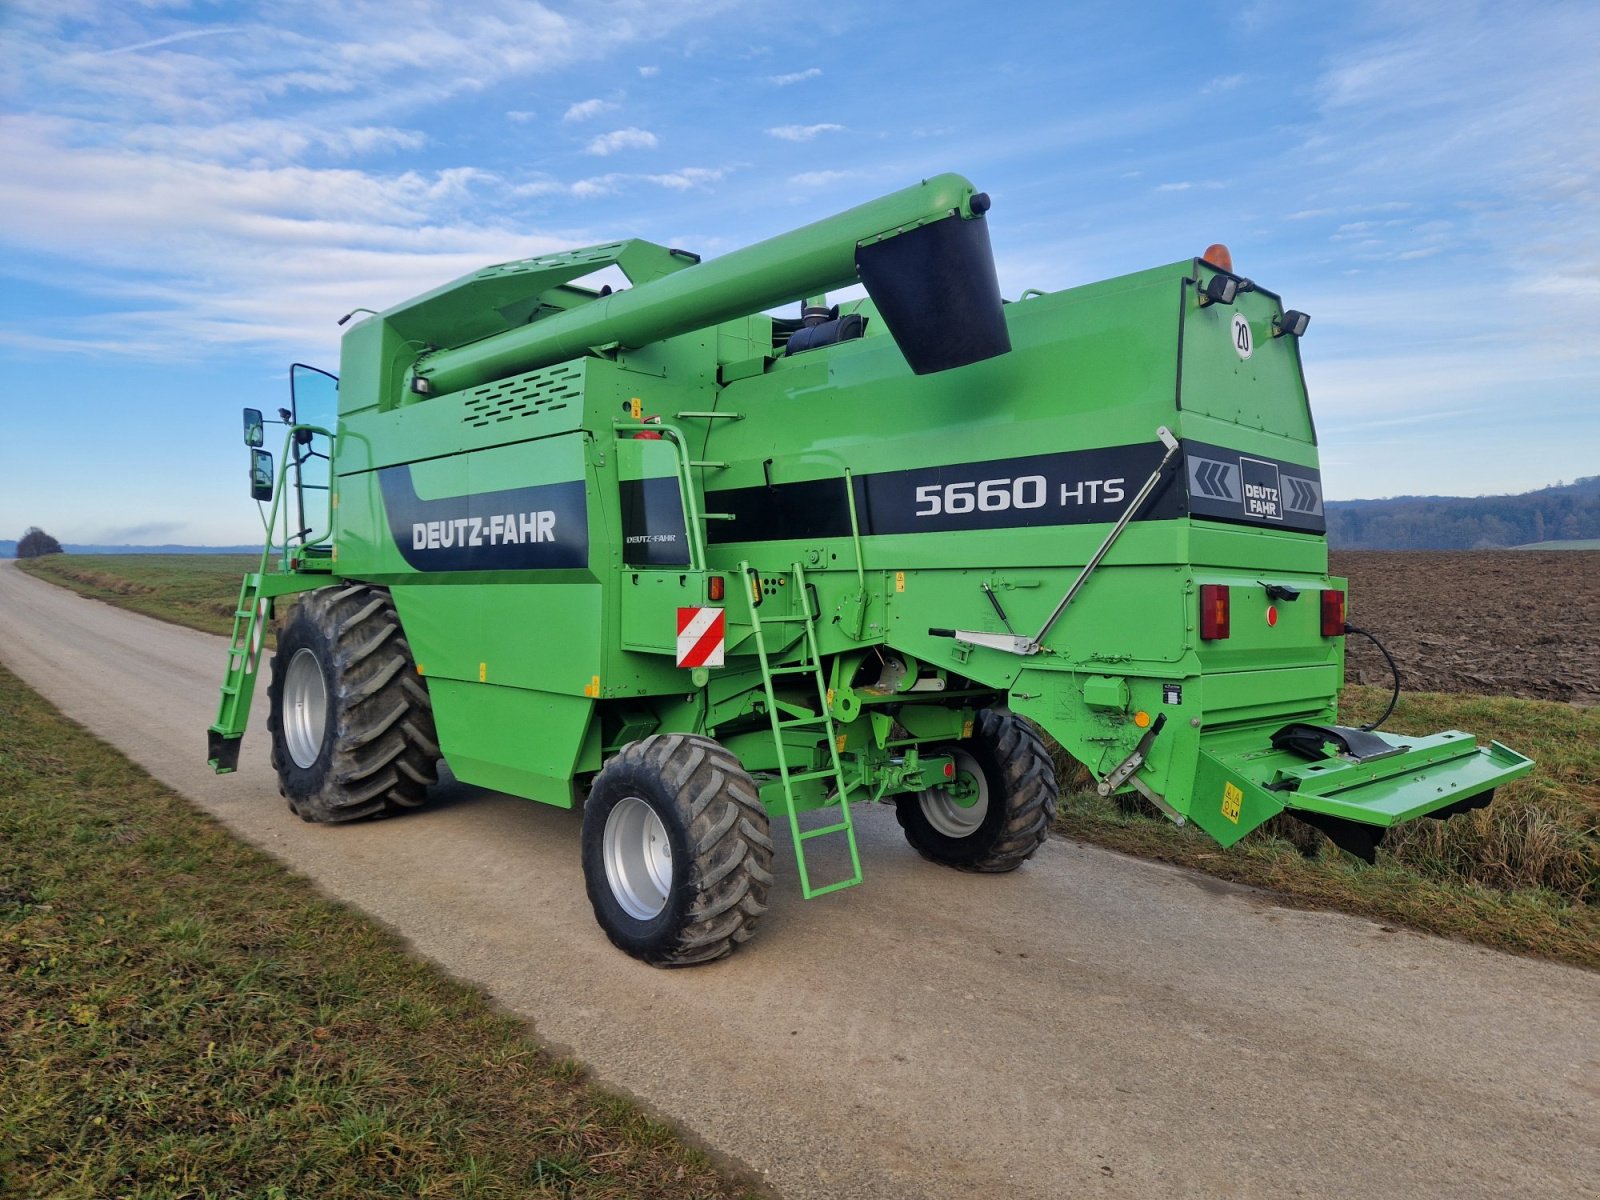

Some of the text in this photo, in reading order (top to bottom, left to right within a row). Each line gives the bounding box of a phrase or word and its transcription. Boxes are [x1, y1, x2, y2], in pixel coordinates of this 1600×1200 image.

[1235, 321, 1249, 352] 20
[915, 475, 1125, 517] 5660 HTS
[1245, 484, 1278, 502] DEUTZ
[1250, 499, 1276, 515] FAHR
[412, 510, 556, 550] DEUTZ-FAHR
[626, 534, 676, 544] DEUTZ-FAHR
